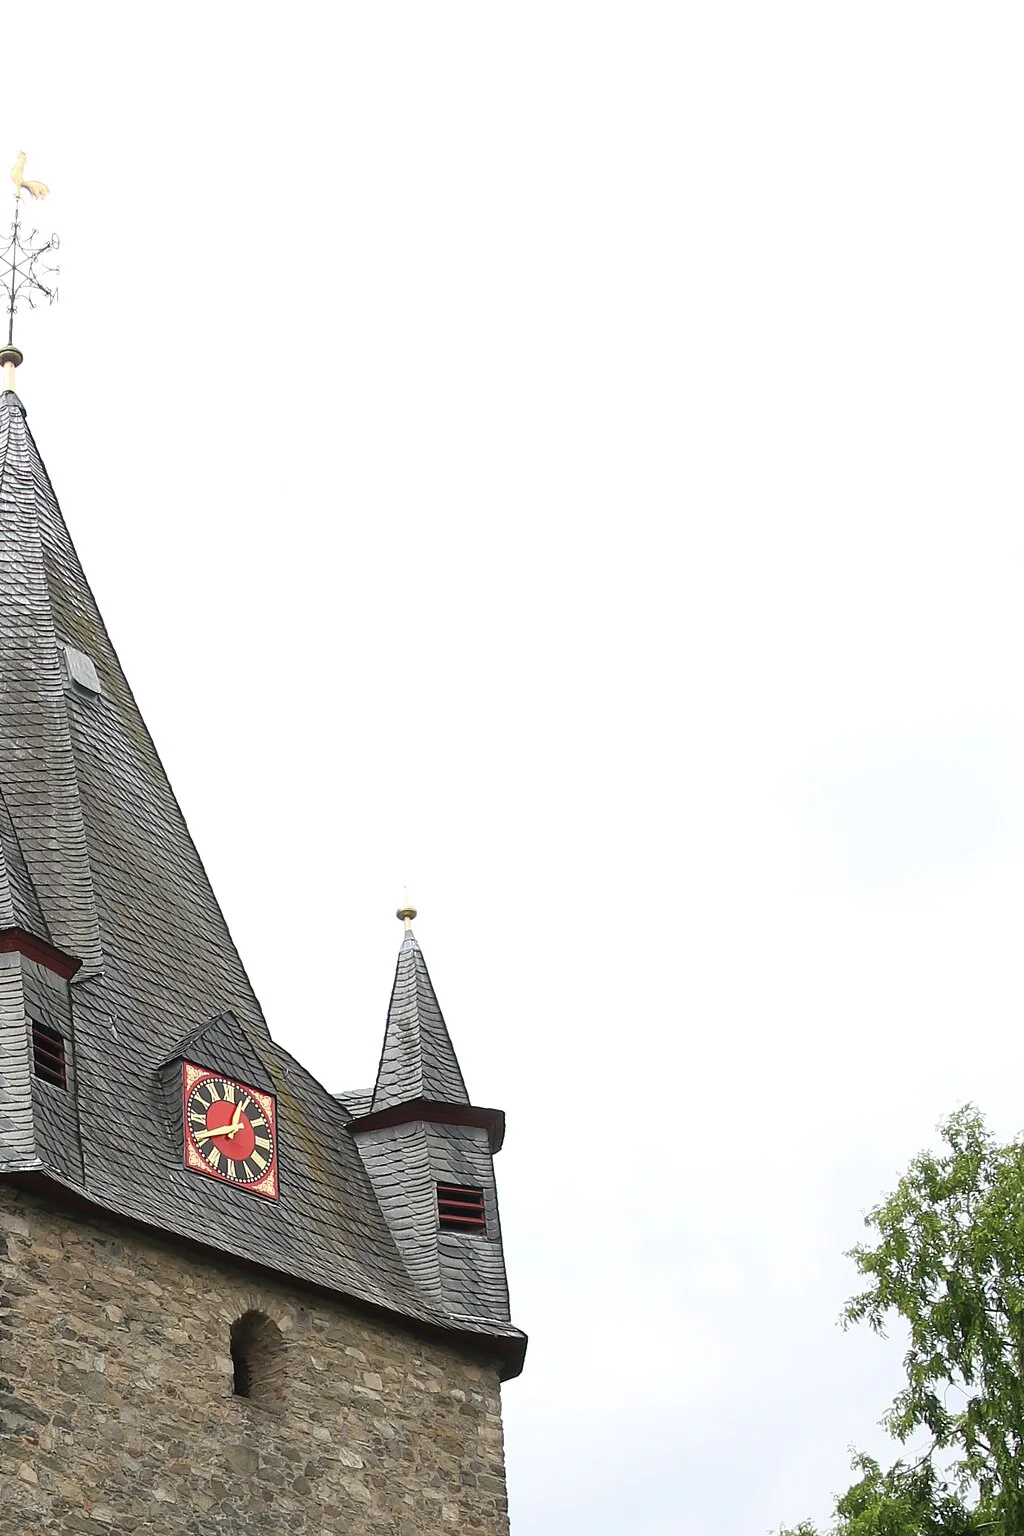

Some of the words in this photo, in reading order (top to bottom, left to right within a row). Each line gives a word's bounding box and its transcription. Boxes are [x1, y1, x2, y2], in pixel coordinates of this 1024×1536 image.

[193, 1091, 211, 1111] X
[205, 1082, 222, 1103] XI
[222, 1083, 236, 1104] XII
[190, 1108, 207, 1126] IX
[254, 1134, 270, 1151] III
[207, 1145, 222, 1168] VII
[242, 1160, 255, 1179] V
